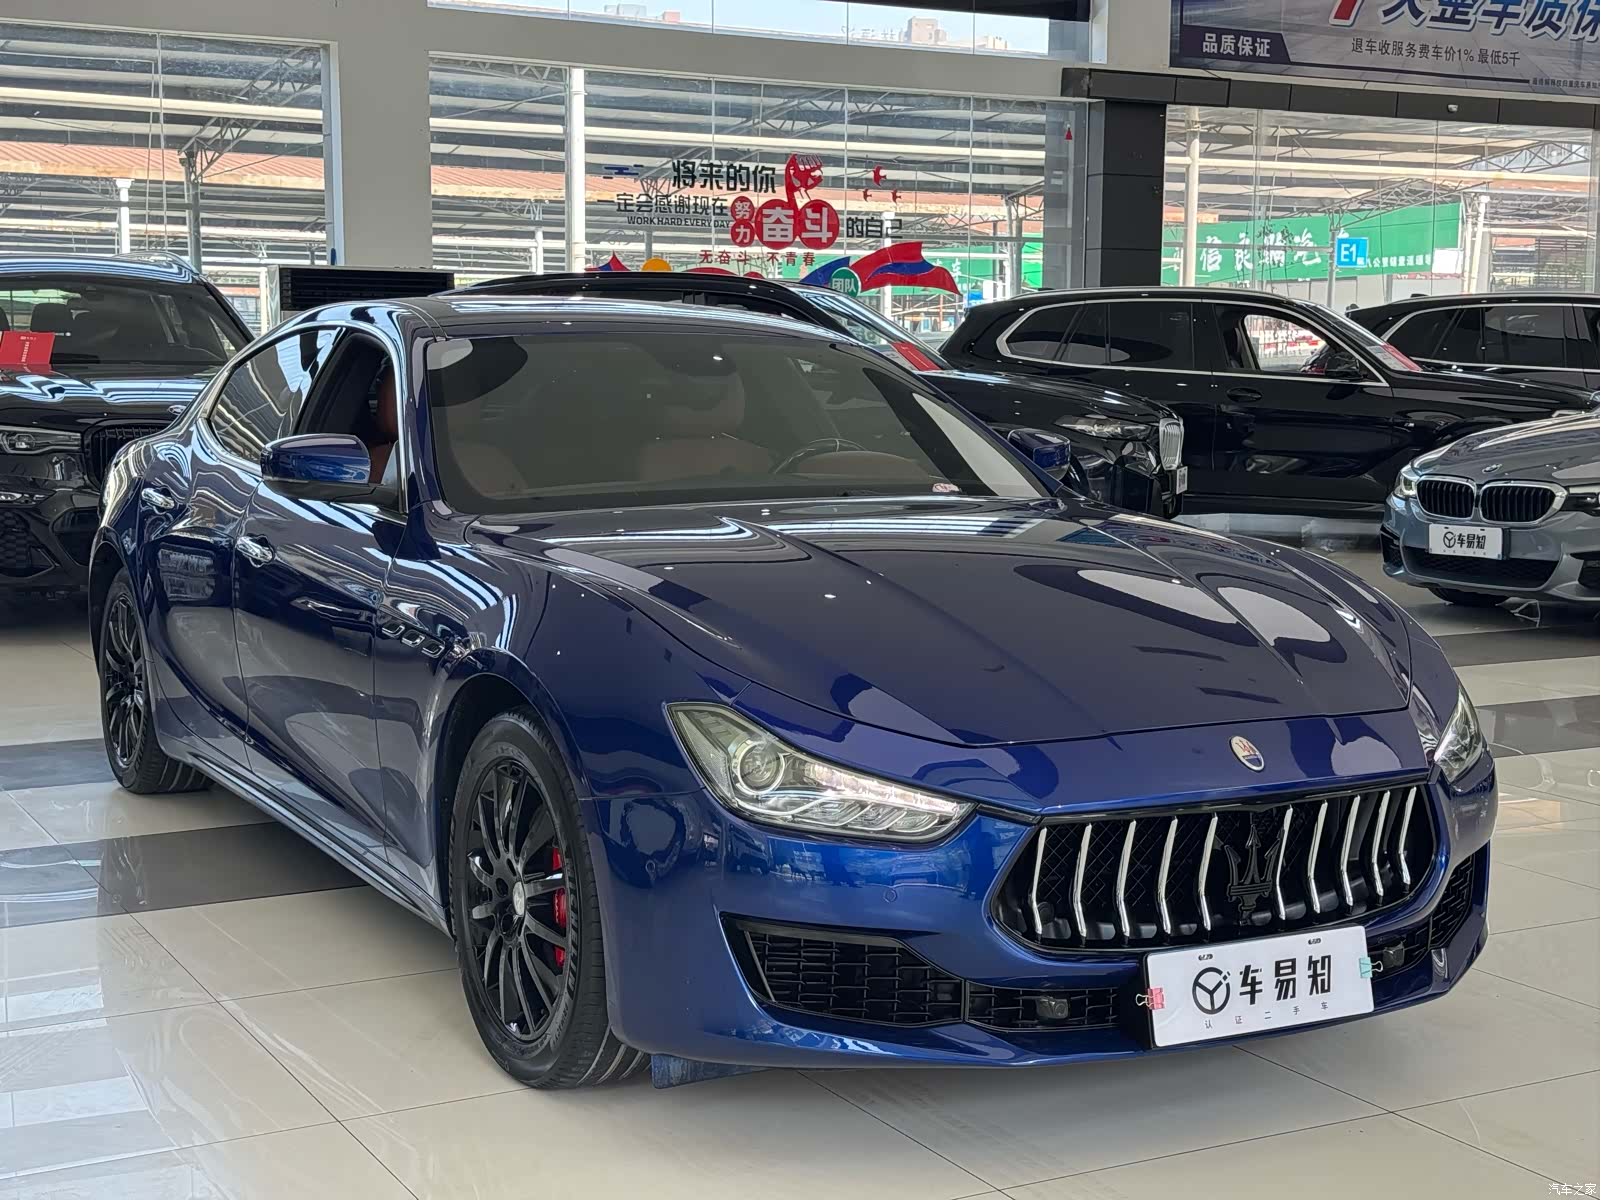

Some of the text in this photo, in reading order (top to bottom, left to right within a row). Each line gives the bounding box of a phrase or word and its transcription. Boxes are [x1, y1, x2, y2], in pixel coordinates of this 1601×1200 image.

[1202, 32, 1271, 57] 品质保证
[1351, 37, 1521, 67] 退车收服务费车价1% 最低5千
[672, 159, 777, 193] 将来的你
[596, 192, 729, 216] 一定会感谢现在
[627, 216, 731, 229] WORK HARD EVERY DAY
[735, 201, 750, 243] 努力
[762, 207, 833, 243] 奋斗
[846, 216, 903, 239] 的自己
[1340, 243, 1357, 262] E1
[832, 277, 857, 294] 团队
[1456, 533, 1487, 549] 车易知
[1239, 954, 1332, 1006] 车易知
[1205, 1001, 1328, 1029] 认证二手车
